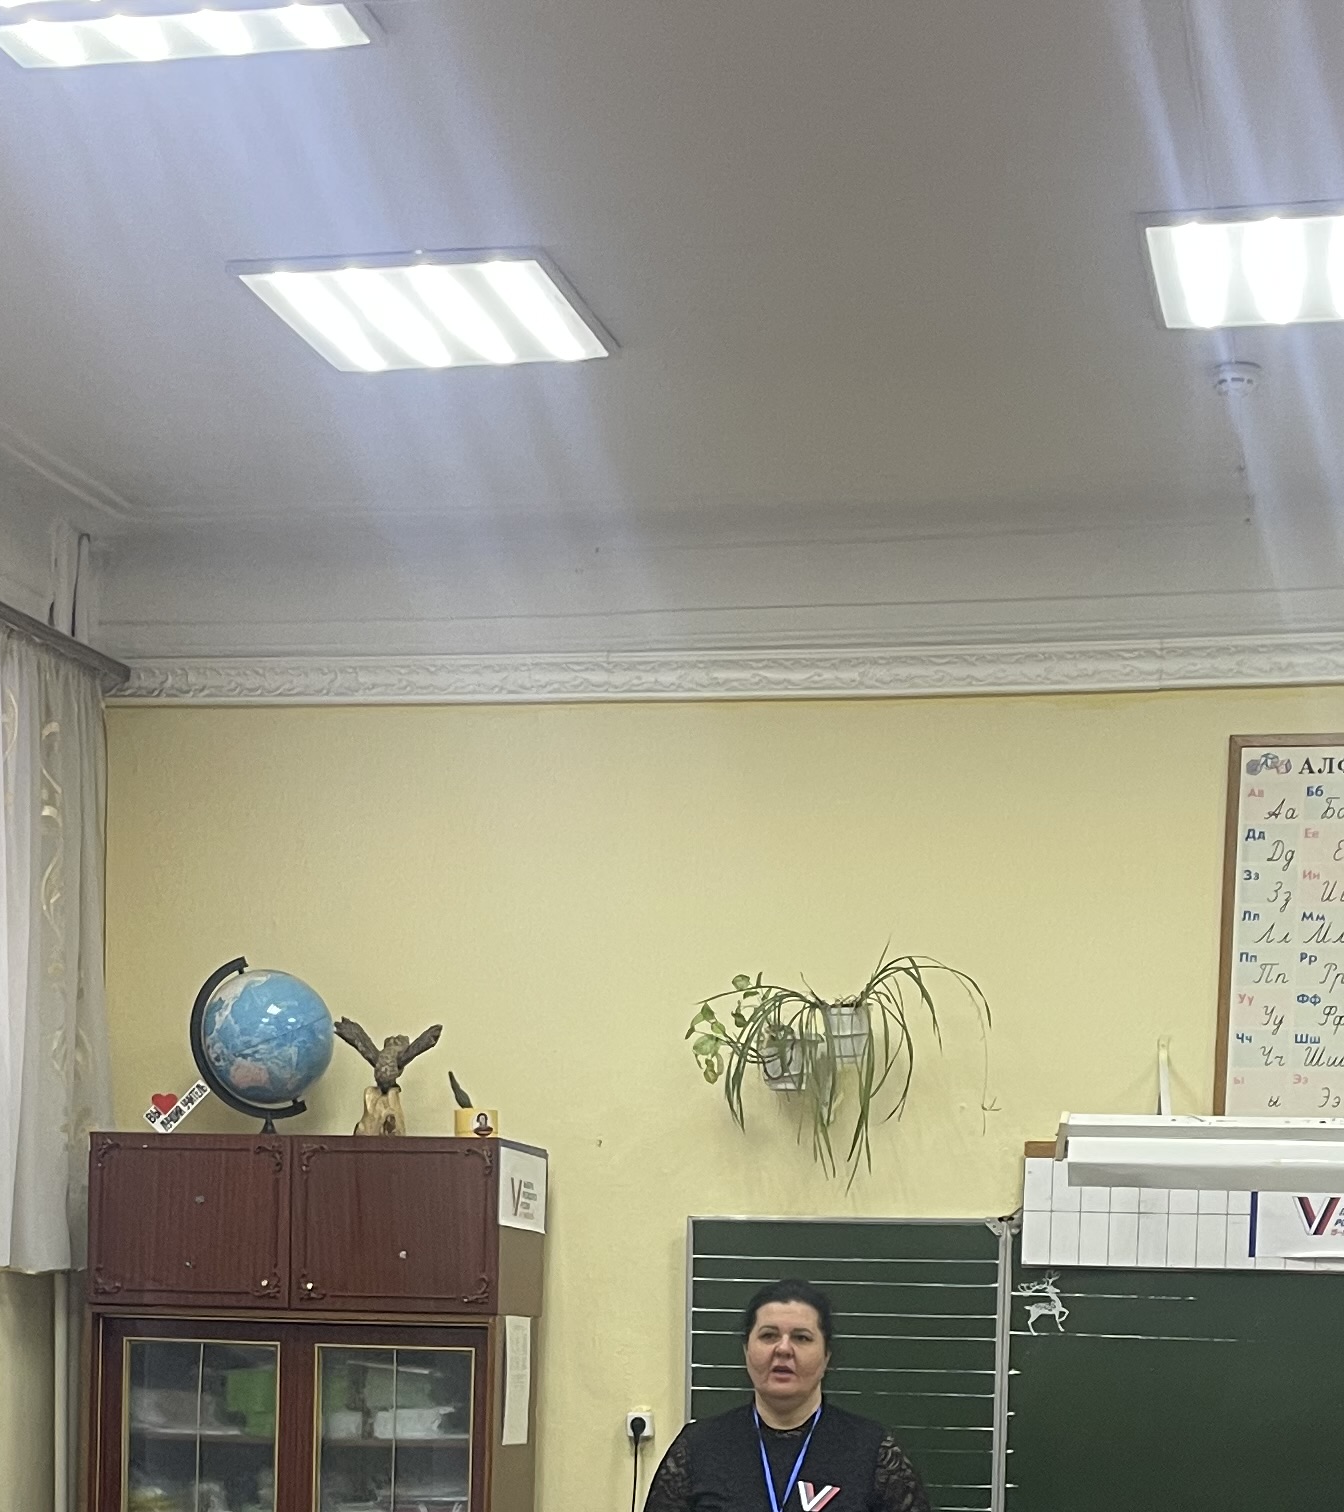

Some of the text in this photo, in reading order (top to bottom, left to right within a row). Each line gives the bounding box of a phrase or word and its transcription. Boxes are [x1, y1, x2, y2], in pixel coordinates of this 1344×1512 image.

[1307, 786, 1323, 796] Бб
[1264, 799, 1298, 820] Аа
[1245, 829, 1265, 841] Дд
[1267, 840, 1295, 871] Дд
[1243, 870, 1259, 880] Зз
[1267, 881, 1292, 912] Зз
[1301, 912, 1325, 921] Мм
[1253, 922, 1292, 944] Лл
[1240, 953, 1257, 962] Пп
[1300, 952, 1317, 963] Рр
[1253, 963, 1289, 984] Пп
[1297, 993, 1321, 1006] Фф
[1261, 1006, 1284, 1035] Уу
[1236, 1033, 1252, 1043] Чч
[1295, 1034, 1320, 1044] Шш
[1260, 1046, 1285, 1067] Чч
[1318, 1087, 1341, 1108] Ээ
